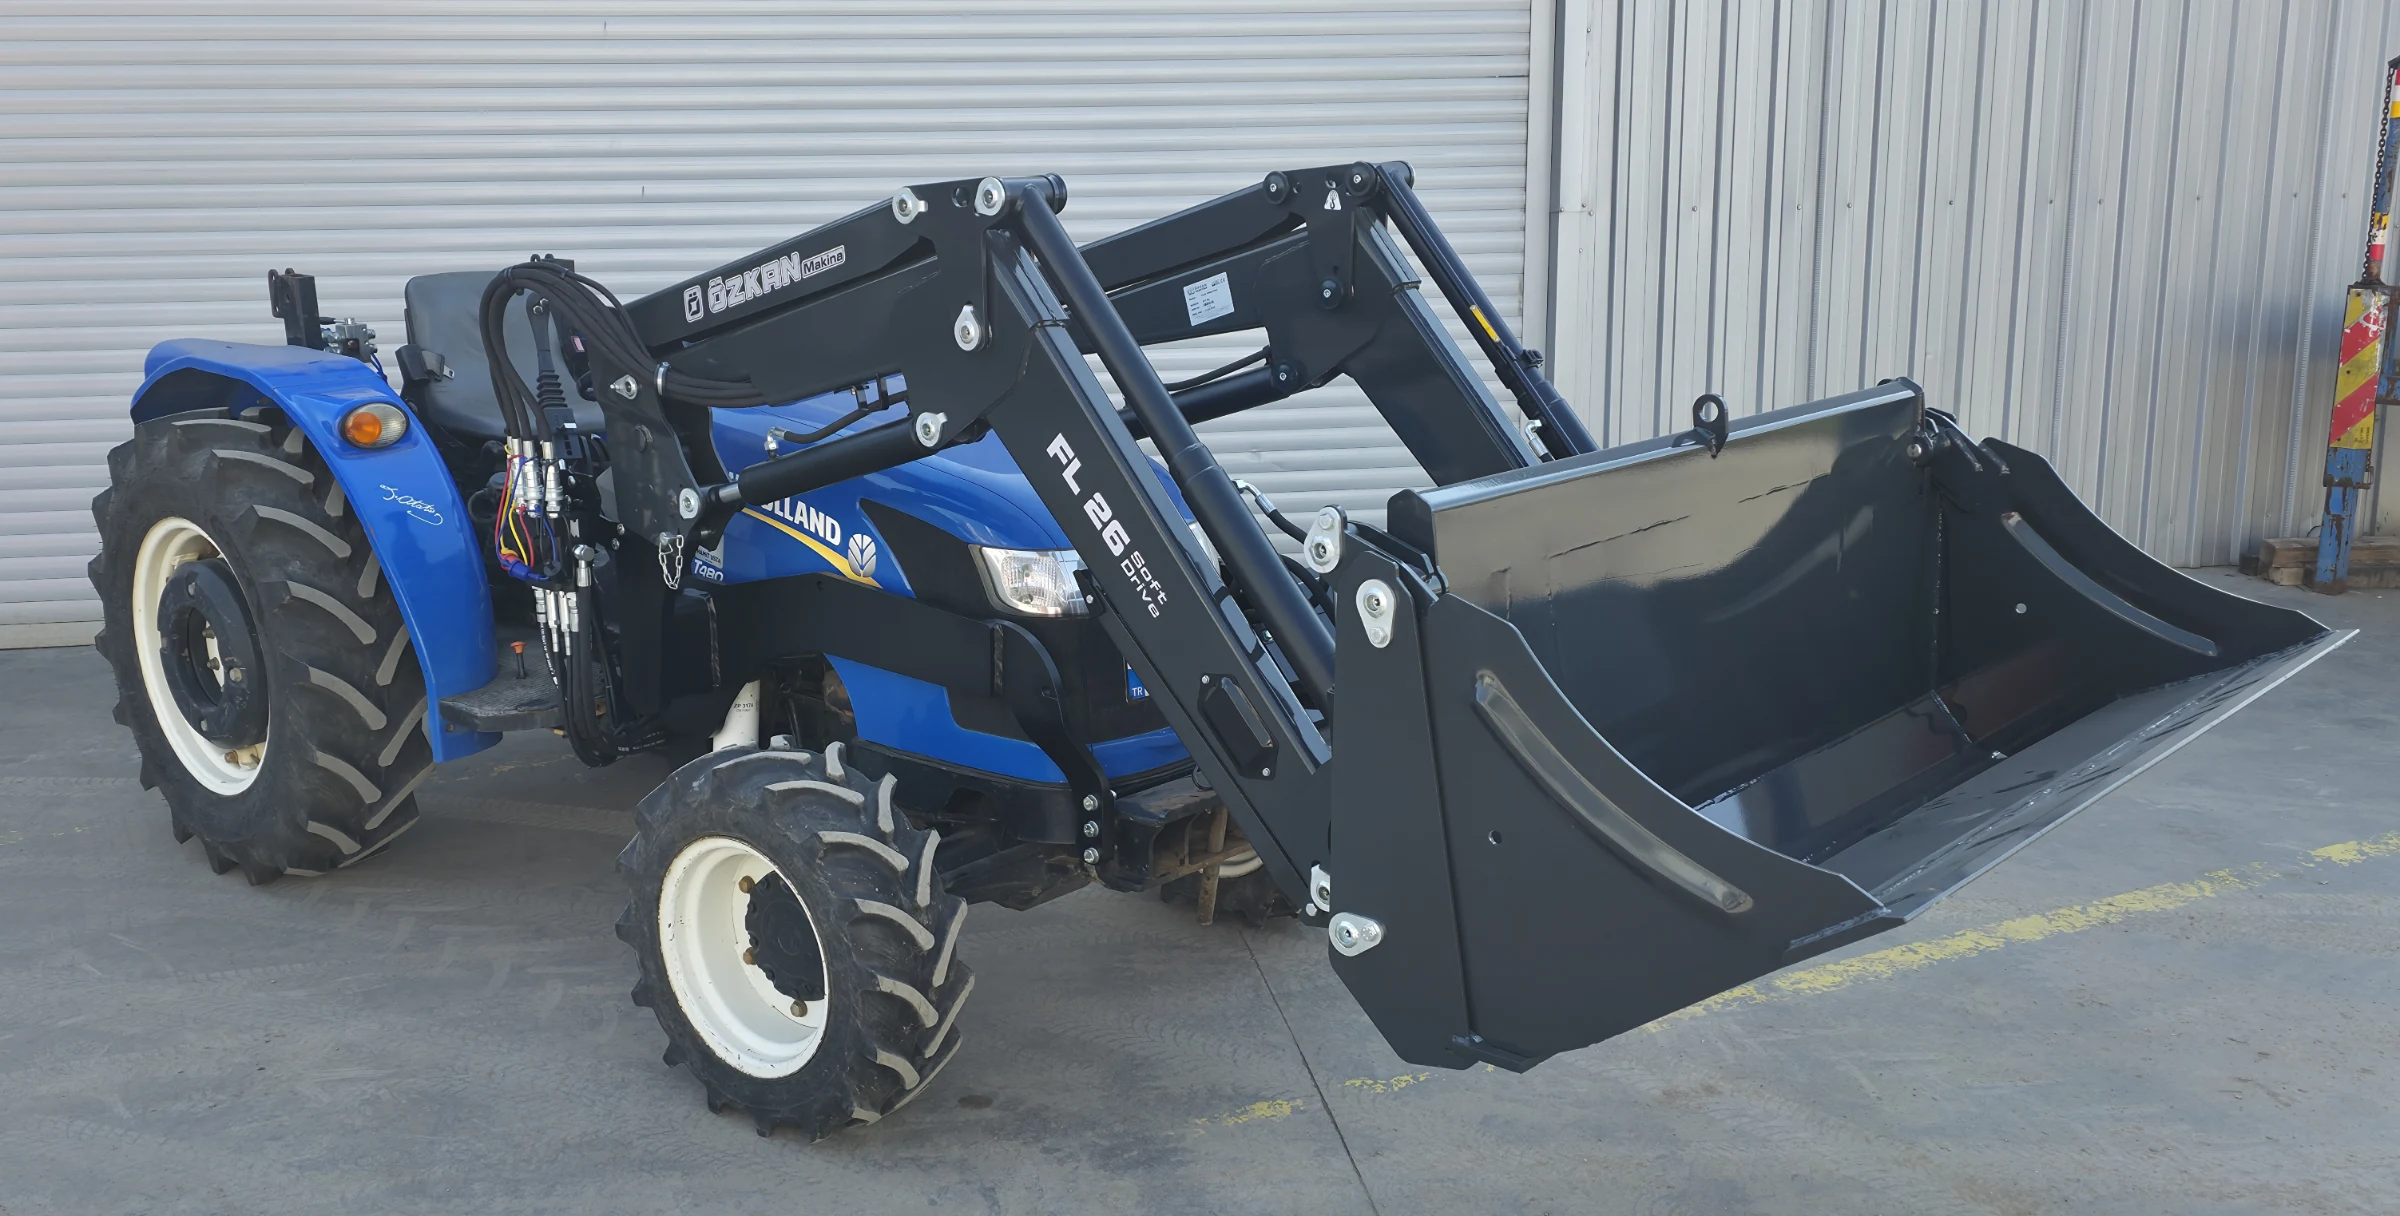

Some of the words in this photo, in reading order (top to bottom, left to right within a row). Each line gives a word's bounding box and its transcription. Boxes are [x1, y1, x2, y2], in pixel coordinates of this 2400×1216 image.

[708, 251, 802, 313] ÖZKAN
[802, 247, 845, 278] Makina
[760, 496, 841, 547] LLAND
[1046, 433, 1082, 495] FL
[1083, 492, 1130, 557] 26
[694, 559, 723, 582] T480
[1120, 559, 1160, 618] Drive
[1130, 551, 1167, 605] Soft
[1131, 686, 1143, 697] TR
